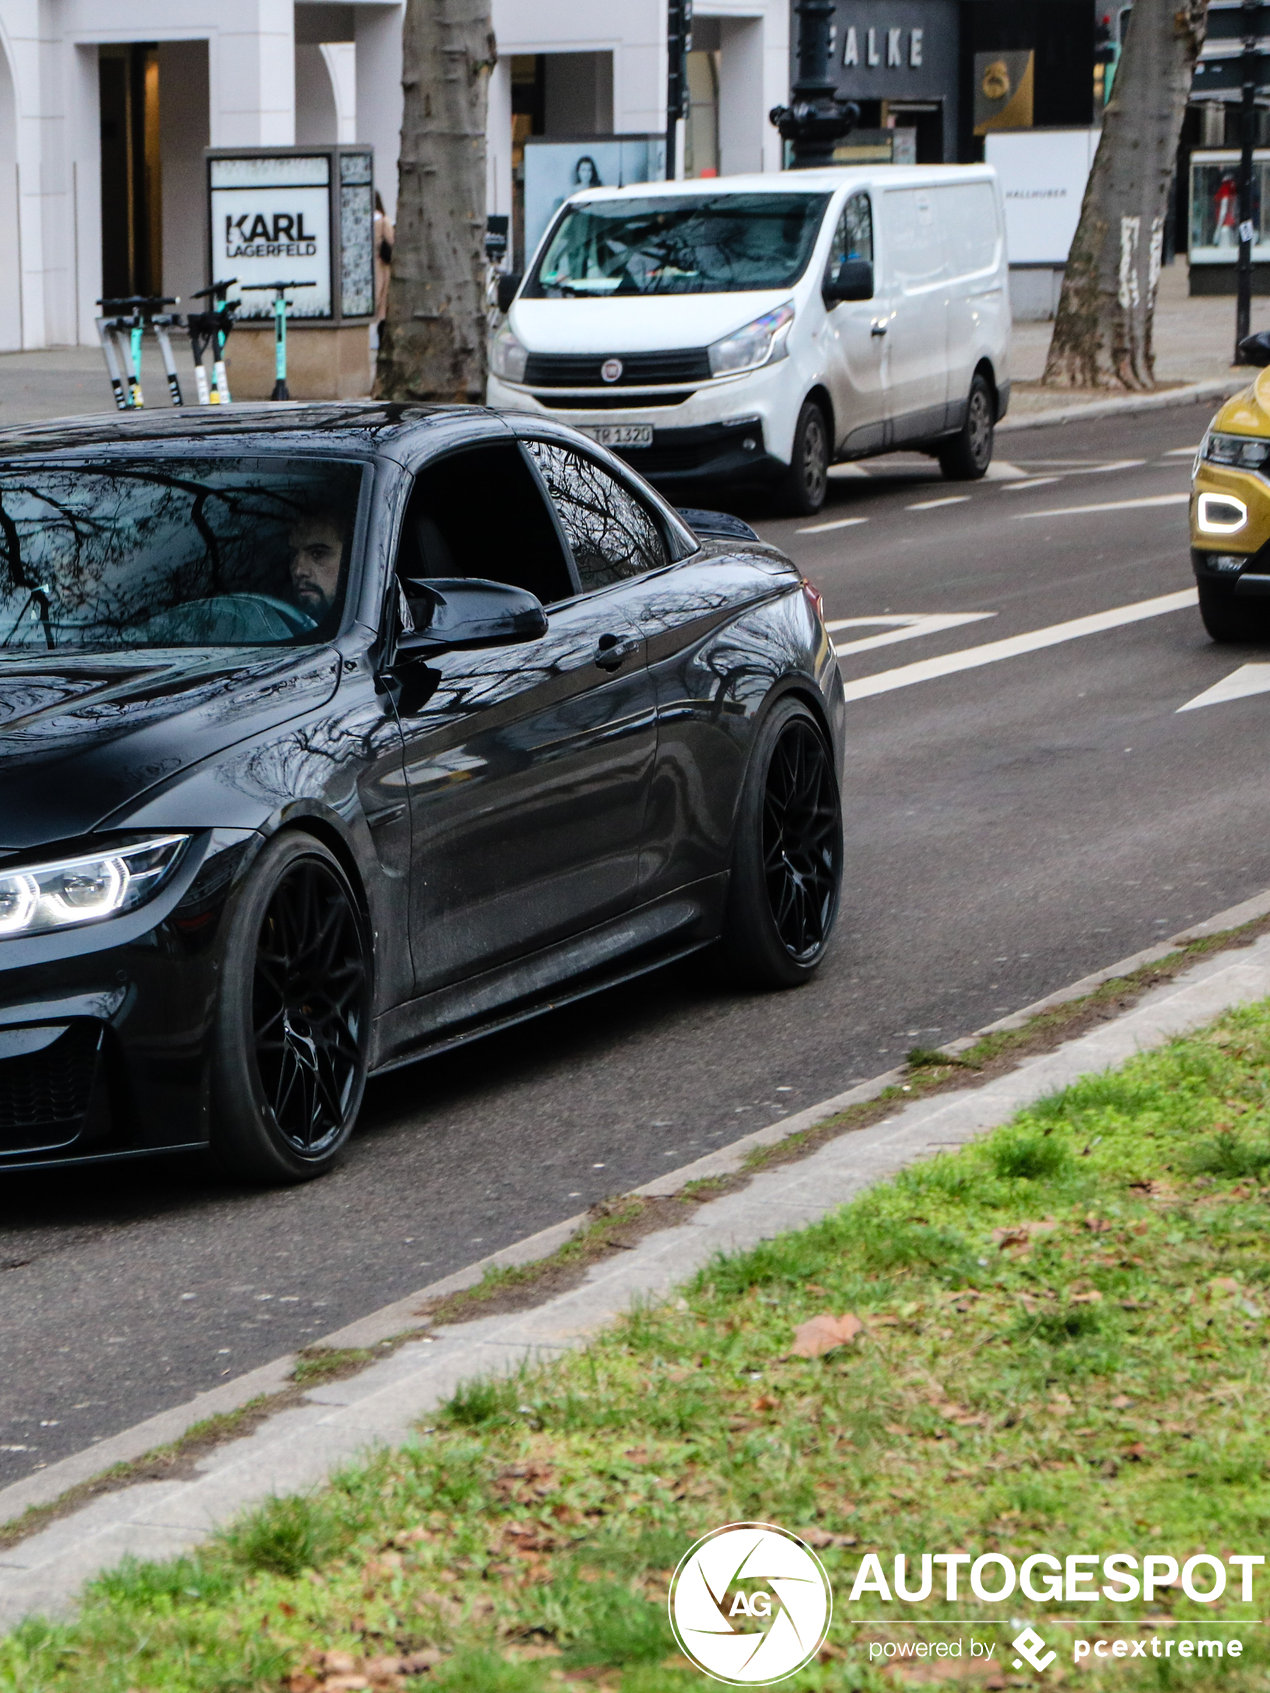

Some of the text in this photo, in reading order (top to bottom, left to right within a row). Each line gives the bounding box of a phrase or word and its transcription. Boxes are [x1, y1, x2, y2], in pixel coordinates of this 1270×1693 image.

[226, 213, 316, 242] KARL
[226, 243, 317, 258] LAGERFELD
[615, 427, 650, 442] 1320
